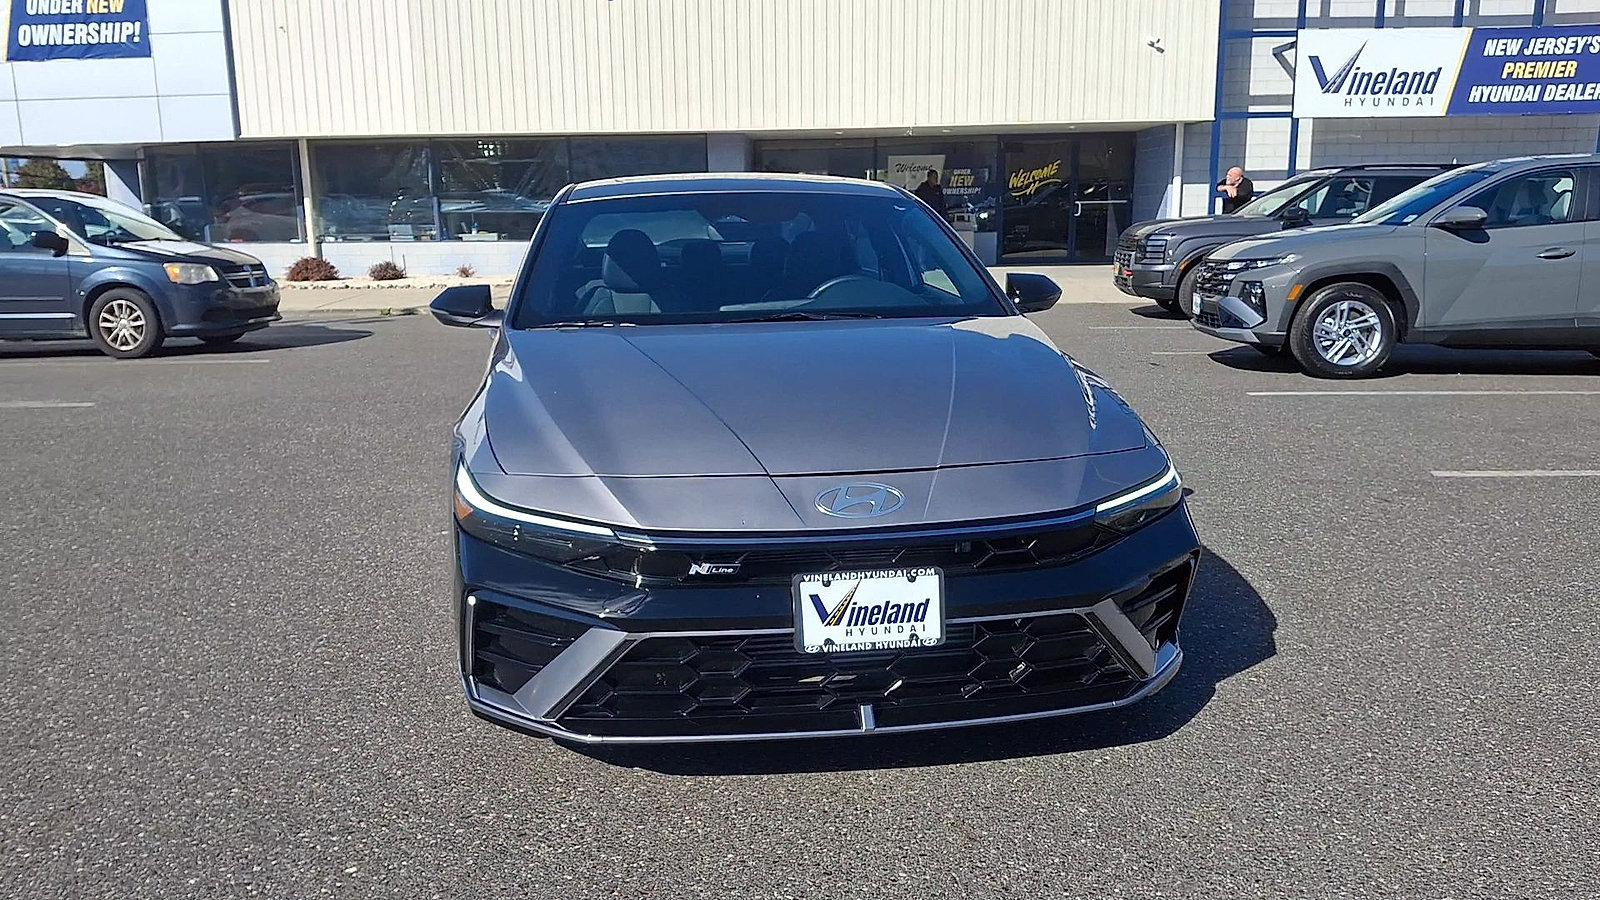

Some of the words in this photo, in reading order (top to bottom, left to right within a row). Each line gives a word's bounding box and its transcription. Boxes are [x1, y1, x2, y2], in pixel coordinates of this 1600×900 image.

[25, 0, 83, 15] UNDER
[85, 0, 125, 14] NEW
[17, 21, 141, 47] OWNERSHIP!
[1482, 38, 1522, 56] NEW
[1524, 35, 1600, 55] JERSEY'S
[1308, 39, 1442, 95] Vineland
[1501, 60, 1578, 79] PREMIER
[1344, 97, 1434, 107] HYUNDAI
[1468, 85, 1541, 103] HYUNDAI
[949, 175, 975, 187] NEW
[1009, 159, 1061, 189] WELCOME
[942, 187, 981, 195] OWNERSHIP!
[803, 568, 935, 582] VINELANDHYUNDAI.COM
[809, 580, 931, 627] Vineland
[845, 624, 926, 637] HYUNDAI
[822, 643, 873, 653] VINELAND
[875, 639, 921, 650] HYUNDAI
